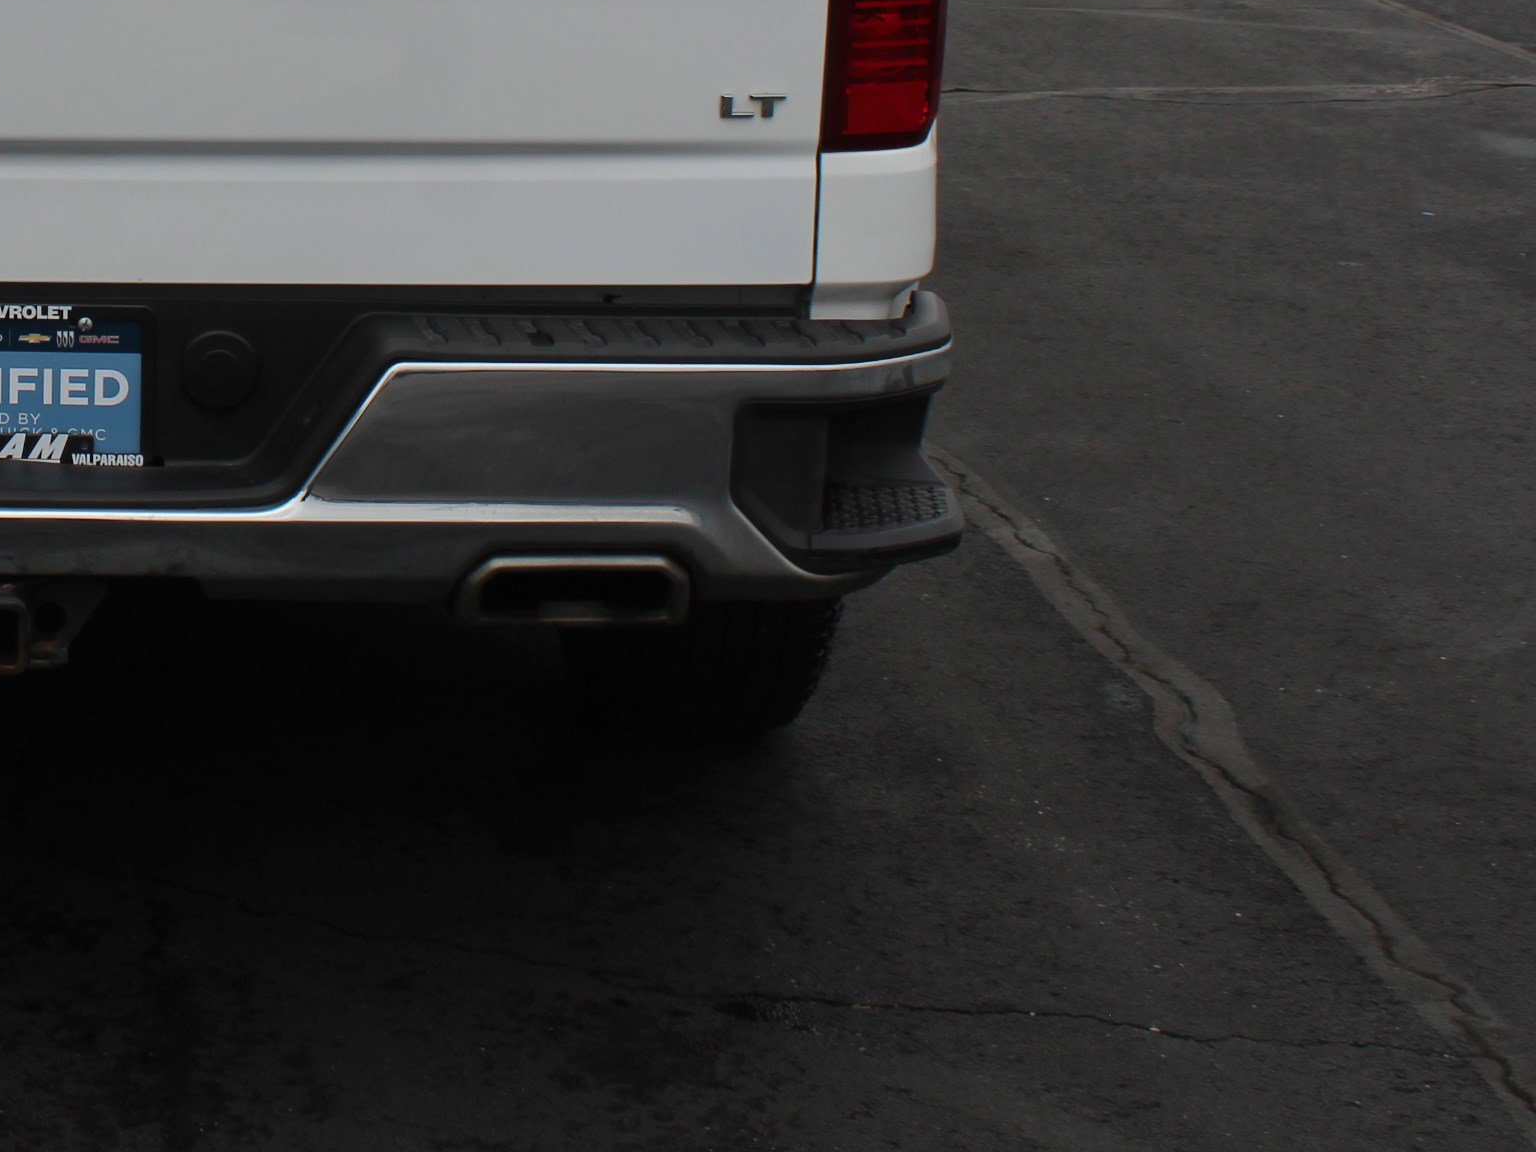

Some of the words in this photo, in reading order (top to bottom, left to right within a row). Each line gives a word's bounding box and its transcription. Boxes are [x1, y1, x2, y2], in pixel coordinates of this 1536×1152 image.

[720, 93, 787, 119] LT
[79, 335, 120, 344] GMC
[18, 412, 41, 425] BY
[71, 453, 144, 467] VALPARAISO
